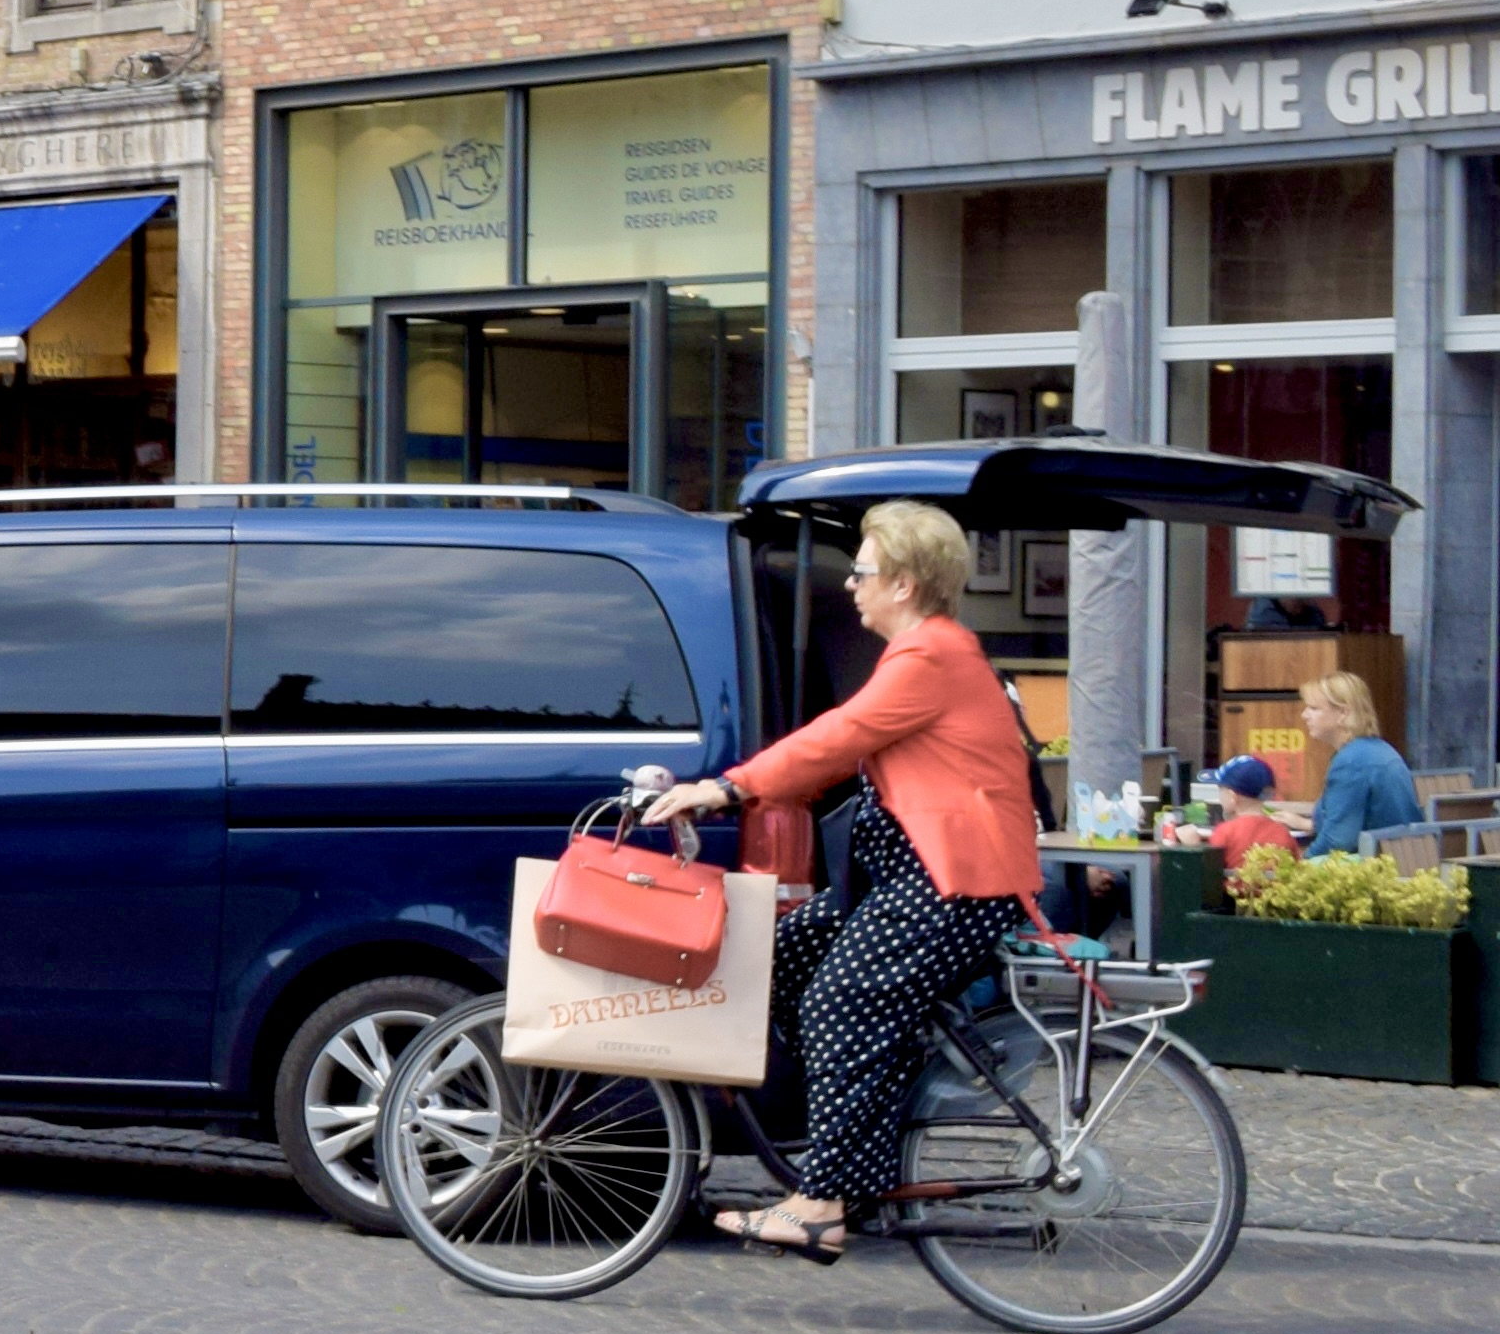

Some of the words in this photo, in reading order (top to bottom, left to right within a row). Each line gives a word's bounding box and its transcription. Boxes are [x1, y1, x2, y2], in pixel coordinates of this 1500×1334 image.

[1092, 58, 1301, 144] FLAME
[624, 163, 677, 182] GUIDES
[681, 162, 701, 178] DE
[704, 157, 769, 175] VOYAGE
[624, 188, 674, 205] TRAVEL
[678, 184, 735, 203] GUIDES
[1248, 728, 1306, 753] FEED
[549, 979, 728, 1029] DANNEELS
